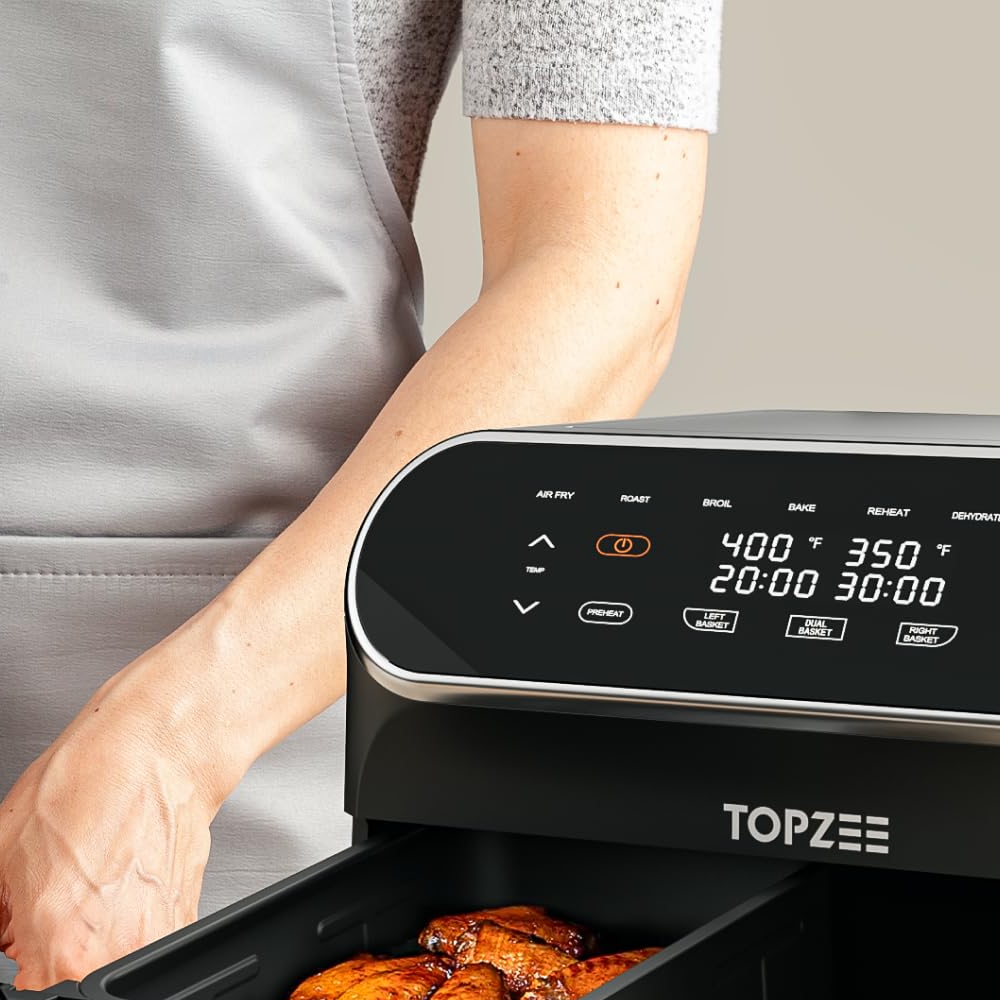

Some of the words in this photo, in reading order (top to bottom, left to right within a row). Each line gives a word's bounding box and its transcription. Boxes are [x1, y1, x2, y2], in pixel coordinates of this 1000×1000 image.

[536, 490, 554, 499] AIR
[554, 491, 575, 500] FRY
[620, 494, 651, 504] ROAST
[702, 498, 733, 508] BROIL
[788, 502, 817, 513] BAKE
[867, 506, 911, 517] REHEAT
[721, 532, 794, 562] 400
[845, 538, 921, 570] 350
[525, 565, 546, 574] TEMP
[710, 564, 819, 598] 20:00
[834, 572, 946, 607] 30:00
[586, 608, 625, 618] PREHEAT
[703, 612, 727, 620] LEFT
[695, 620, 731, 629] BASKET
[804, 618, 828, 628] DUAL
[797, 626, 834, 637] BASKET
[908, 626, 939, 635] RIGHT
[903, 634, 940, 644] BASKET
[723, 803, 890, 854] TOPZEE
